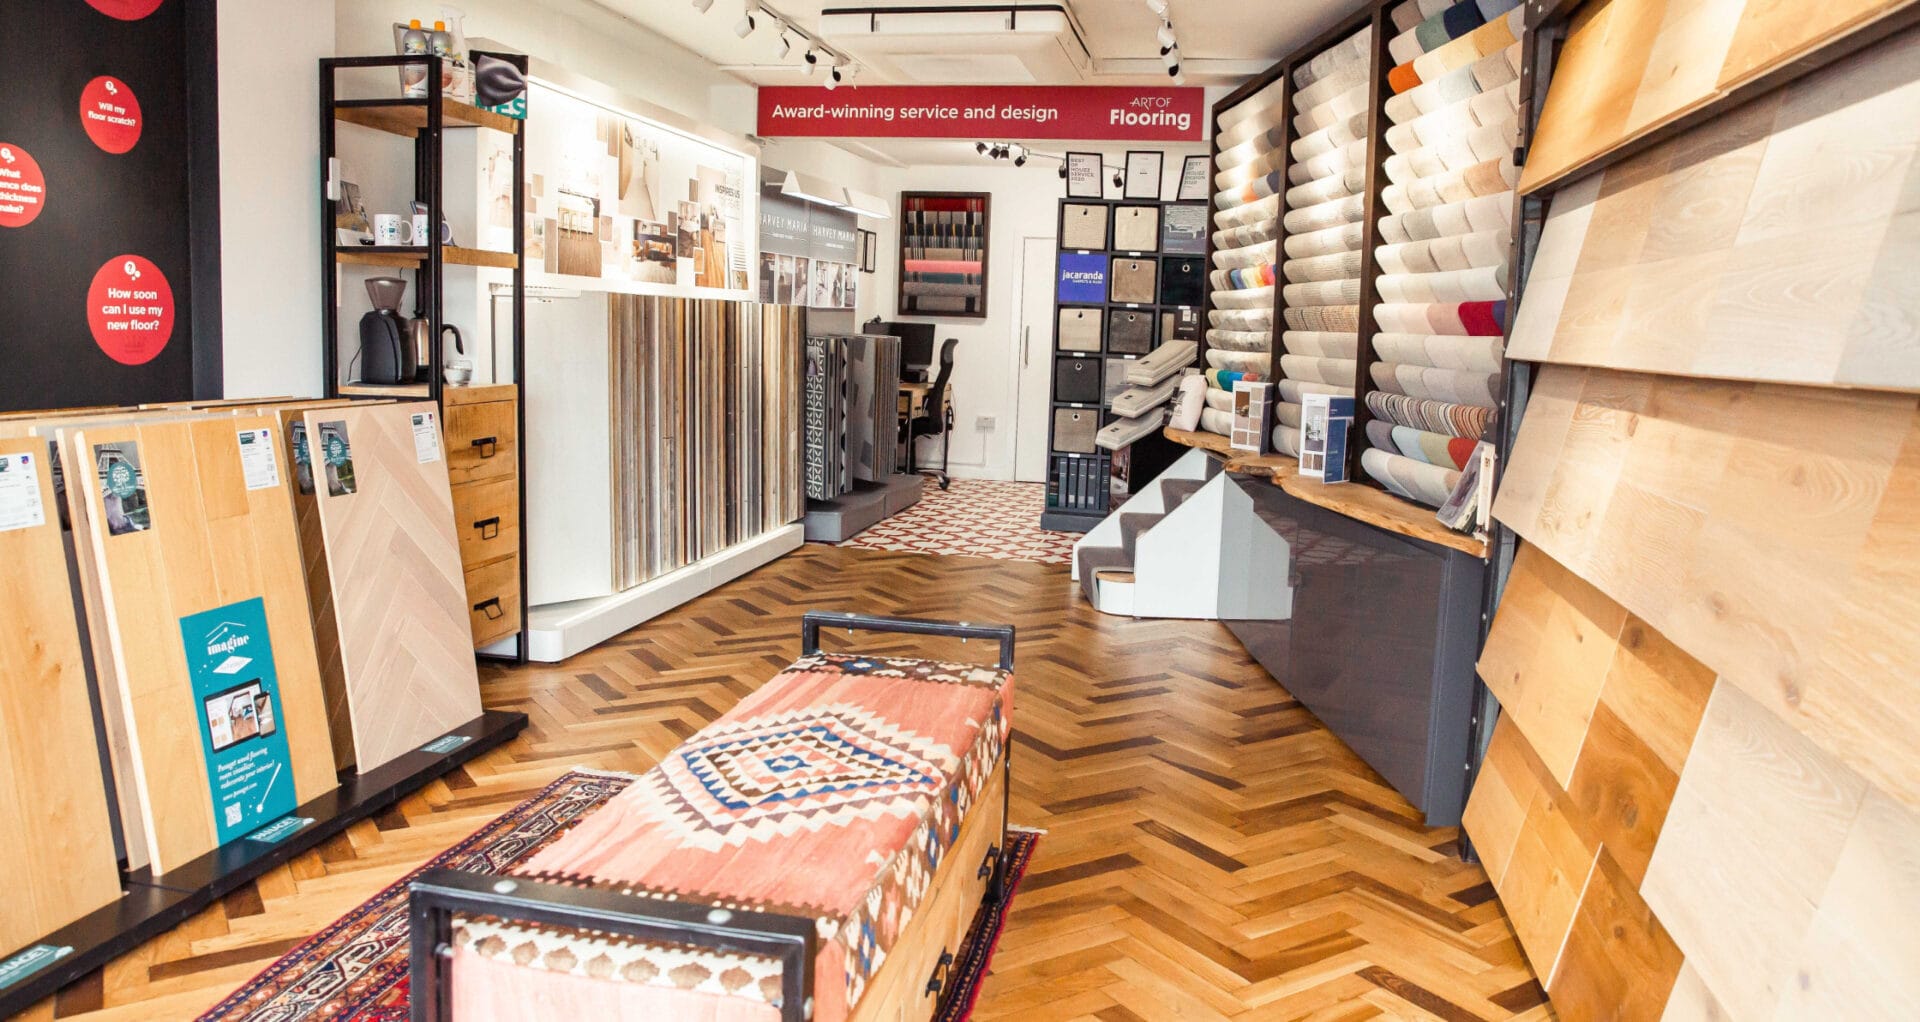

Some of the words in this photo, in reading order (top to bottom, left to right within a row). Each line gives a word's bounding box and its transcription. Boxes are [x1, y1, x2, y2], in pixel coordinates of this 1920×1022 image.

[98, 101, 113, 112] Will
[114, 104, 126, 115] my
[1130, 97, 1156, 110] ART
[1156, 97, 1172, 107] OF
[88, 110, 106, 122] floor
[107, 115, 136, 127] scratch?
[772, 104, 895, 121] Award-winning
[899, 104, 958, 119] service
[963, 104, 996, 119] and
[1000, 104, 1058, 122] design
[1110, 109, 1191, 131] Flooring
[20, 182, 42, 193] does
[787, 218, 808, 233] MARIA
[813, 225, 837, 241] HARVEY
[838, 230, 856, 242] MARIA
[1062, 269, 1104, 281] jacaranda
[107, 288, 131, 299] How
[133, 290, 158, 300] soon
[102, 305, 121, 315] can
[123, 303, 127, 315] I
[128, 306, 146, 315] use
[148, 306, 163, 317] my
[107, 321, 128, 331] new
[130, 319, 160, 331] floor?
[207, 634, 250, 656] imagine
